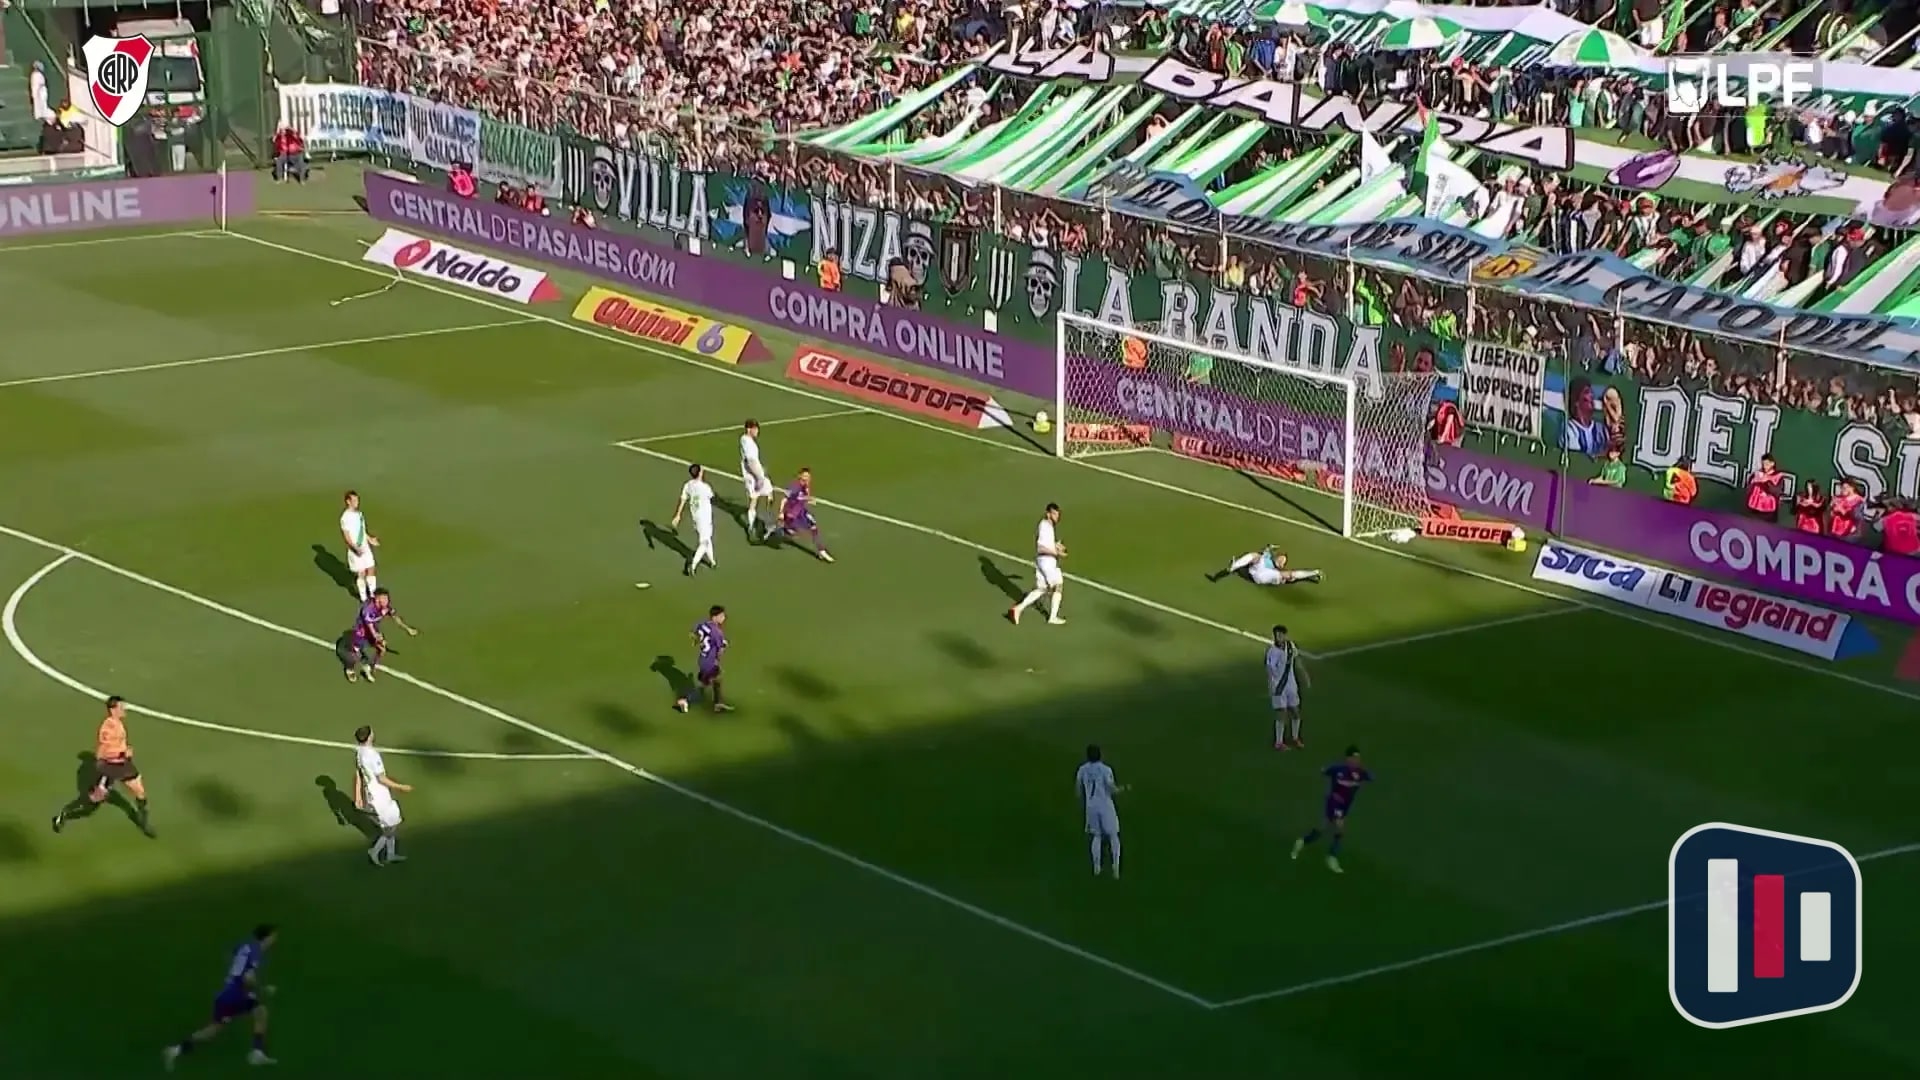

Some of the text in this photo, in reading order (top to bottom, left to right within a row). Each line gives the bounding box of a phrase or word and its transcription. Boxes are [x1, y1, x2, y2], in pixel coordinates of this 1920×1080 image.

[1140, 56, 1574, 172] BANDA
[0, 187, 142, 227] NLINE
[422, 248, 522, 293] Naldo
[593, 296, 729, 355] Quini 6
[613, 149, 710, 240] VILLA
[809, 192, 902, 284] NIZA
[1060, 252, 1137, 332] LA
[1161, 279, 1384, 399] BANDA
[1633, 384, 1796, 500] DEL
[769, 285, 1005, 380] COMPRÁ ONLINE
[1602, 274, 1776, 333] CAPO
[1780, 312, 1897, 351] DEL
[1470, 345, 1540, 377] LIBERTAD
[1464, 402, 1533, 435] VILLA NIZA
[1689, 520, 1892, 607] COMPRÁ
[1694, 583, 1837, 643] legrand
